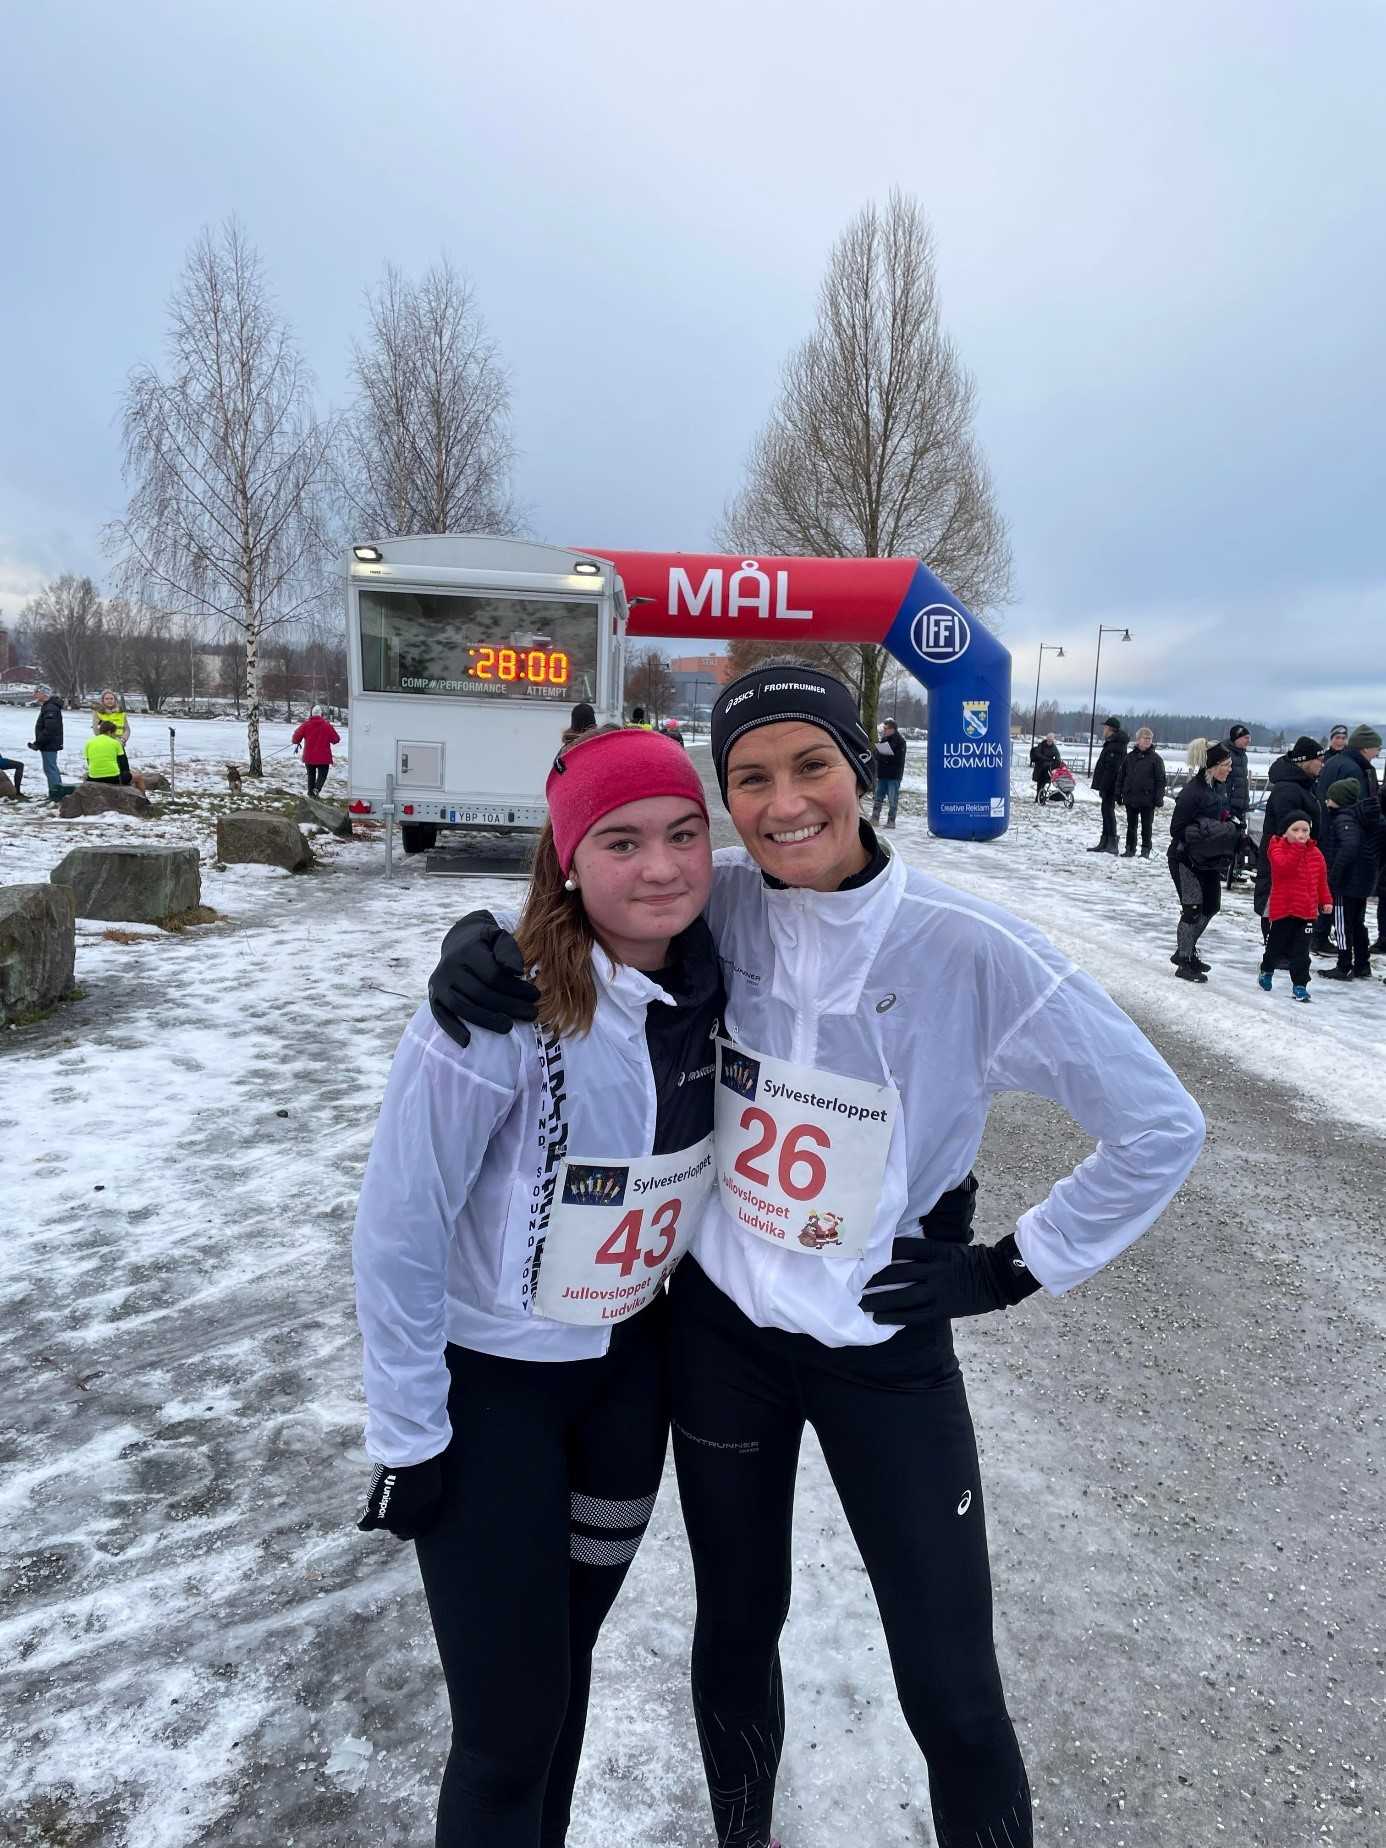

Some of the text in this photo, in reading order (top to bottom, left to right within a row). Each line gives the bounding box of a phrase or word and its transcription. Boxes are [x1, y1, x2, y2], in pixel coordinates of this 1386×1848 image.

[668, 560, 813, 619] MÅL
[527, 686, 568, 697] ATTEMPT
[764, 682, 826, 694] FRONTRUNNER
[944, 743, 1003, 755] LUDVIKA
[943, 757, 1003, 768] KOMMUN
[459, 812, 478, 822] YBP
[763, 1079, 888, 1122] Sylvesterloppet
[733, 1106, 831, 1201] 26
[633, 1153, 712, 1194] Sylvesterloppet
[738, 1207, 786, 1239] Ludvika
[595, 1198, 682, 1277] 43
[561, 1276, 651, 1300] Jullovsloppet
[601, 1296, 646, 1319] Ludvika
